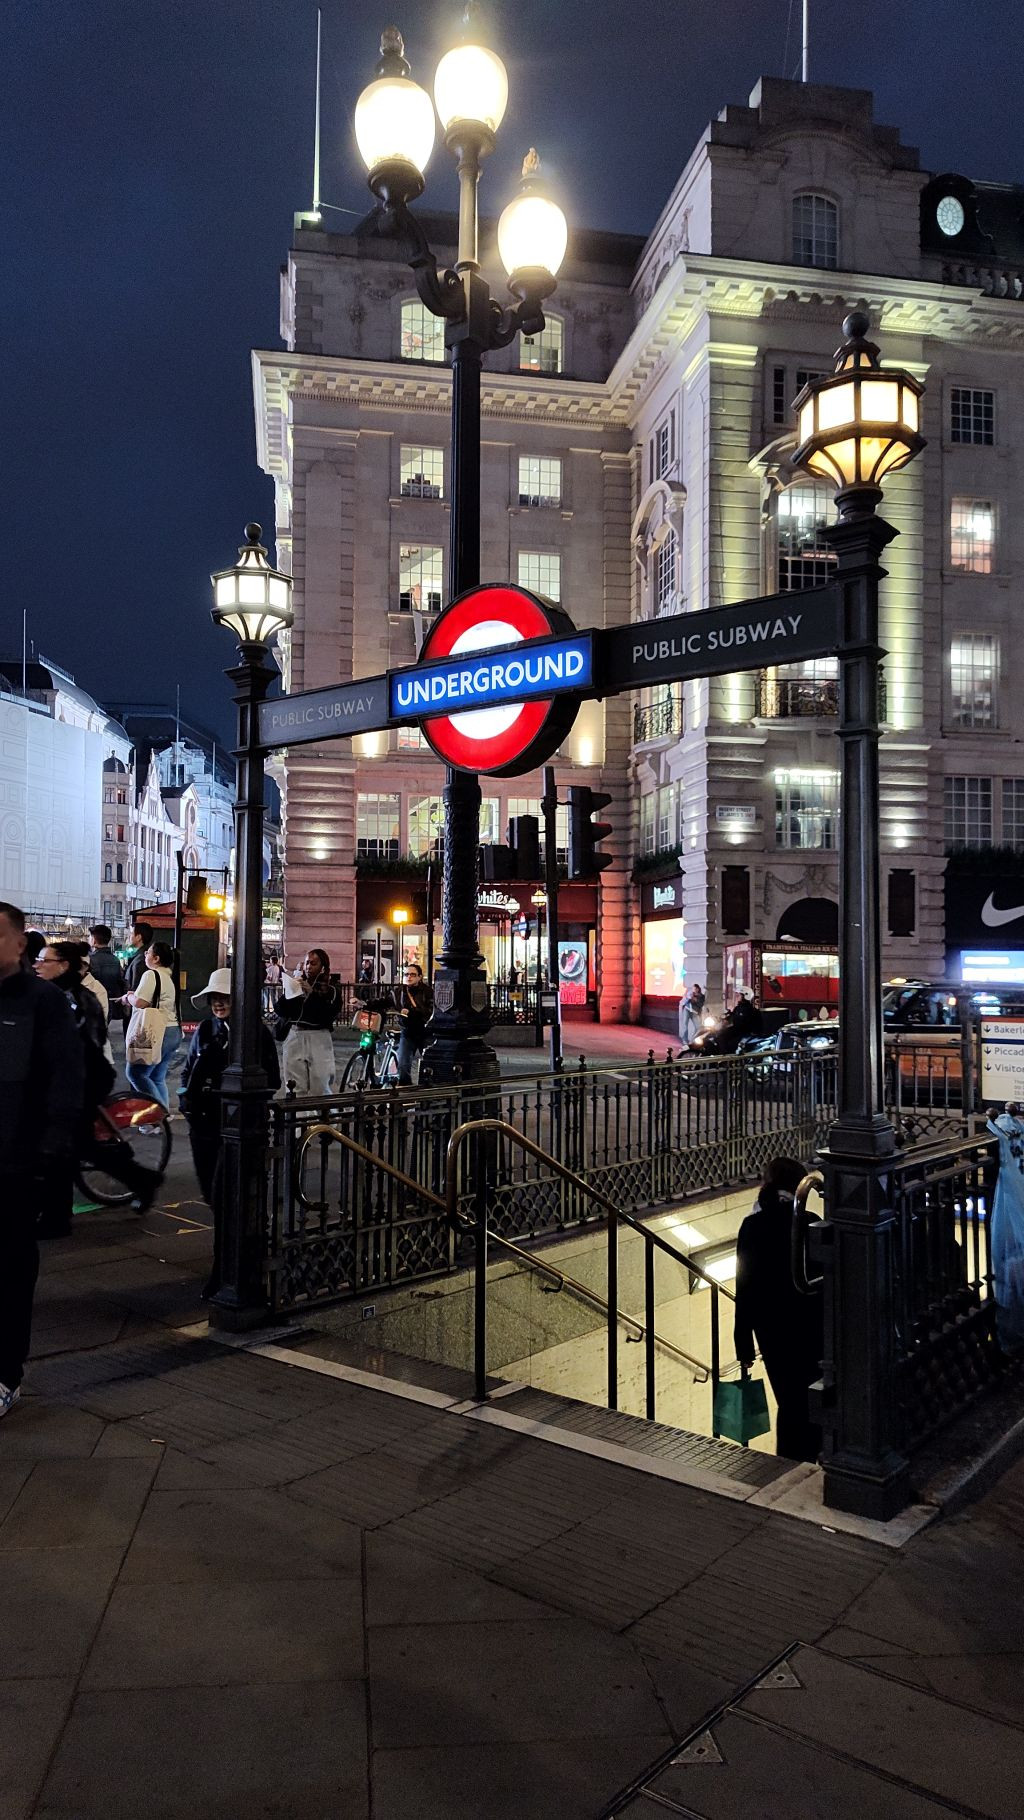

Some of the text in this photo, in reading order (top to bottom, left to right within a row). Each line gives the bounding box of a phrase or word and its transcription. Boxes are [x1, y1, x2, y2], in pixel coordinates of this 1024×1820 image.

[632, 614, 802, 664] PUBLIC SUBWAY
[397, 650, 584, 706] UNDERGROUND
[272, 696, 374, 728] PUBLIC SUBWAY
